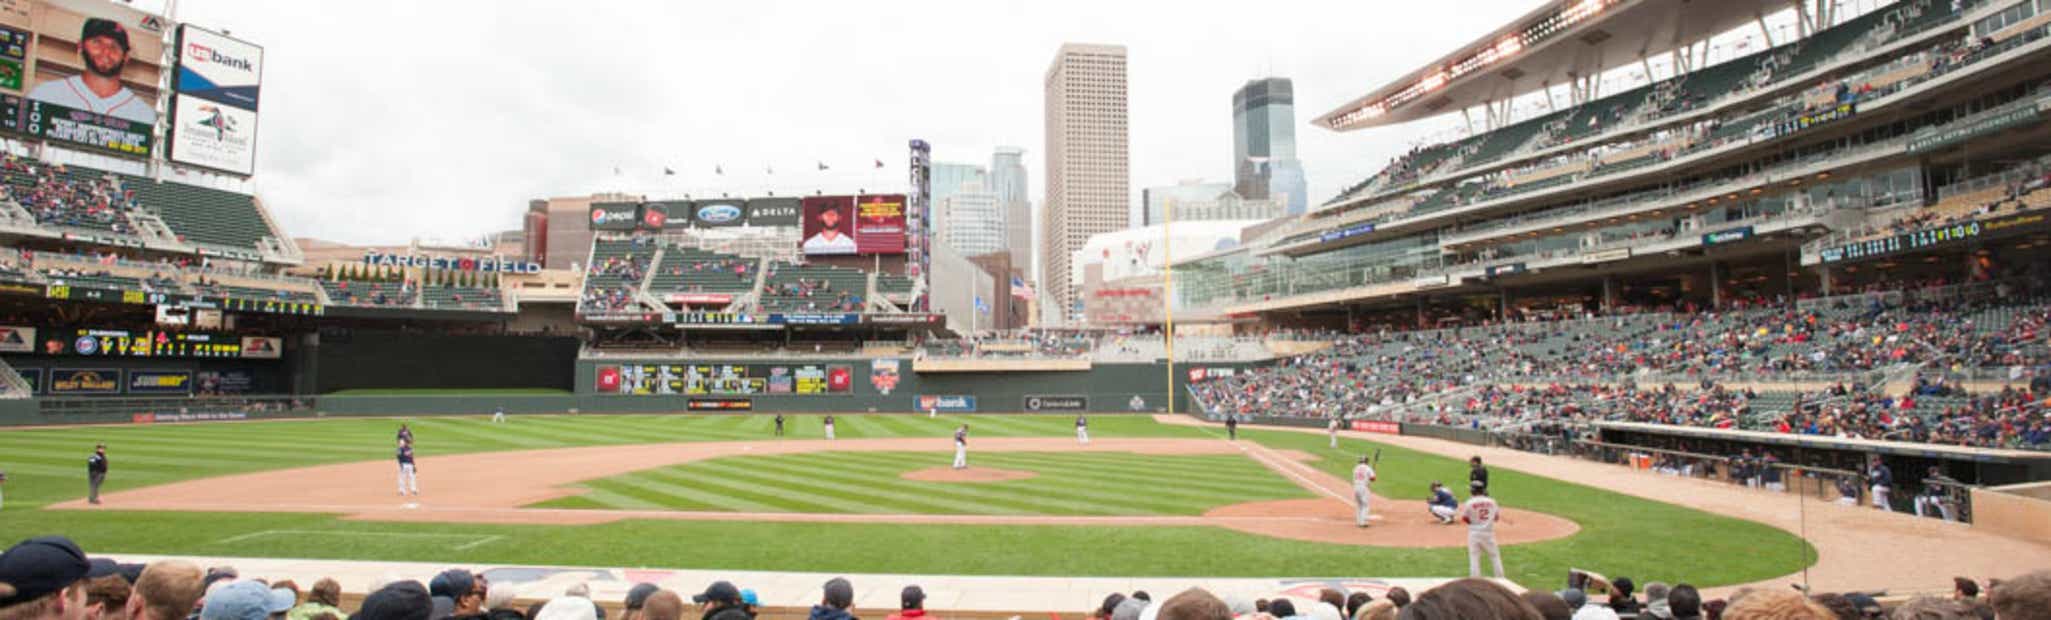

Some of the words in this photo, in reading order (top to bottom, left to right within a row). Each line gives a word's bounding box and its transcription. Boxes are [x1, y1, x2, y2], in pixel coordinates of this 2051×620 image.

[762, 207, 796, 218] DELTA
[366, 252, 456, 271] TARGET
[480, 261, 542, 273] FIELD
[133, 374, 188, 387] SUBWAY
[1479, 509, 1488, 520] 2
